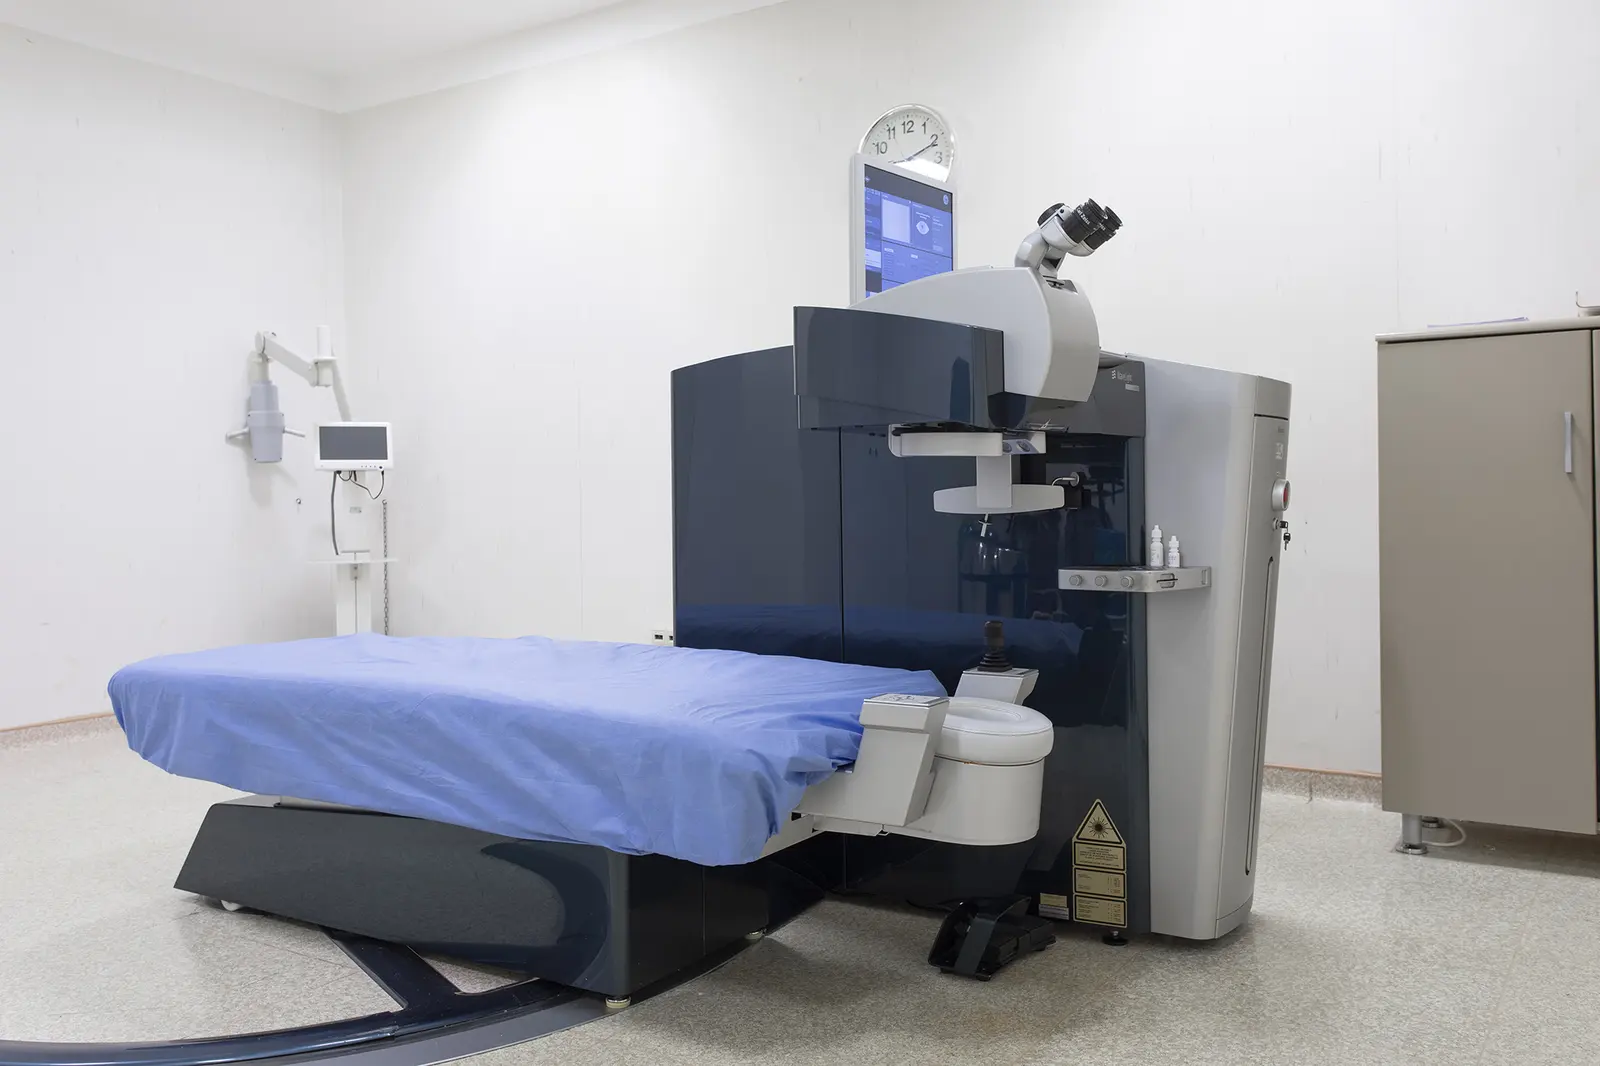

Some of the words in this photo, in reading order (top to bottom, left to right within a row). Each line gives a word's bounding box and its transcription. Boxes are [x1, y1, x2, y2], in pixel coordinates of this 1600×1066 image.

[886, 126, 896, 140] 11
[901, 120, 915, 134] 12
[921, 121, 927, 135] 1
[930, 133, 939, 147] 2
[875, 141, 888, 155] 10
[934, 151, 943, 164] 3
